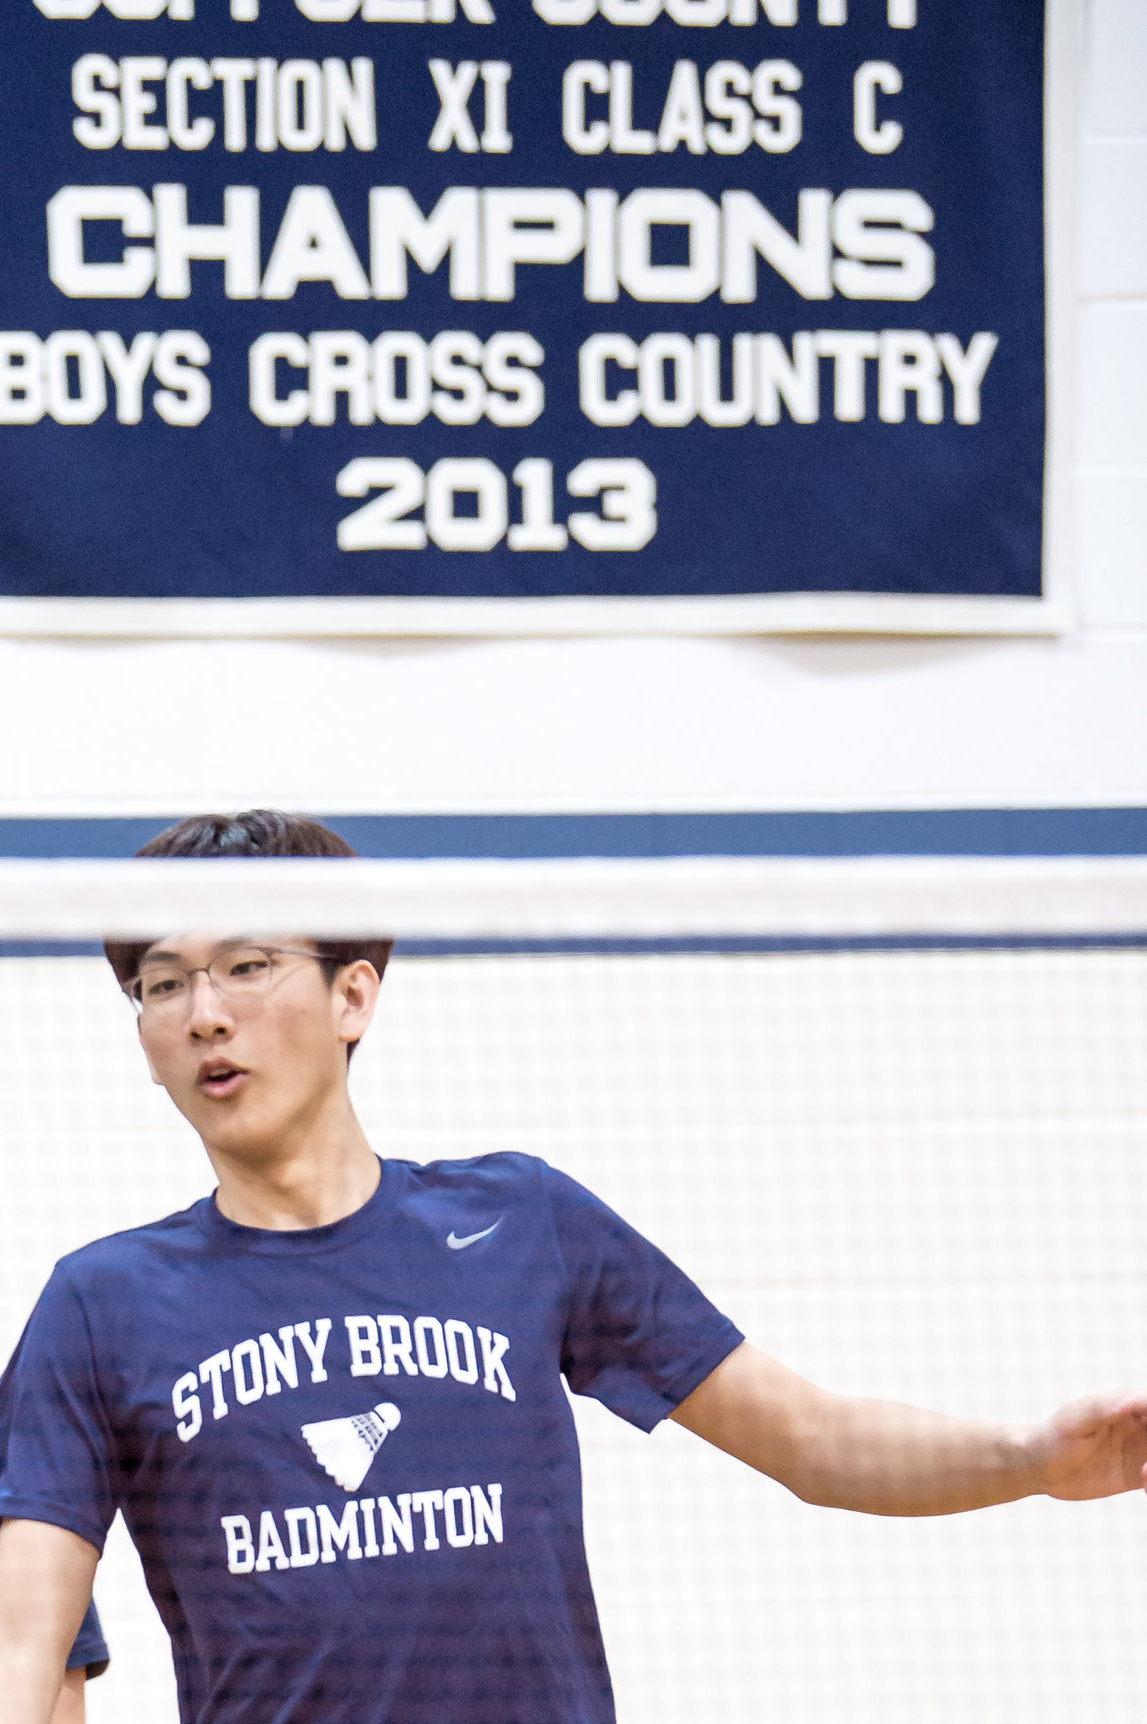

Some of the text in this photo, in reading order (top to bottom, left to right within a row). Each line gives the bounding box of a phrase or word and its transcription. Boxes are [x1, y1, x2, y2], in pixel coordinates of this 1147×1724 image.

[71, 53, 903, 155] SECTION XI CLASS C
[47, 184, 935, 303] CHAMPIONS
[248, 330, 545, 427] CROSS
[578, 330, 998, 427] COUNTRY
[335, 457, 657, 552] 2013
[171, 1314, 516, 1443] STONY BROOK
[220, 1483, 504, 1574] BADMINTON
